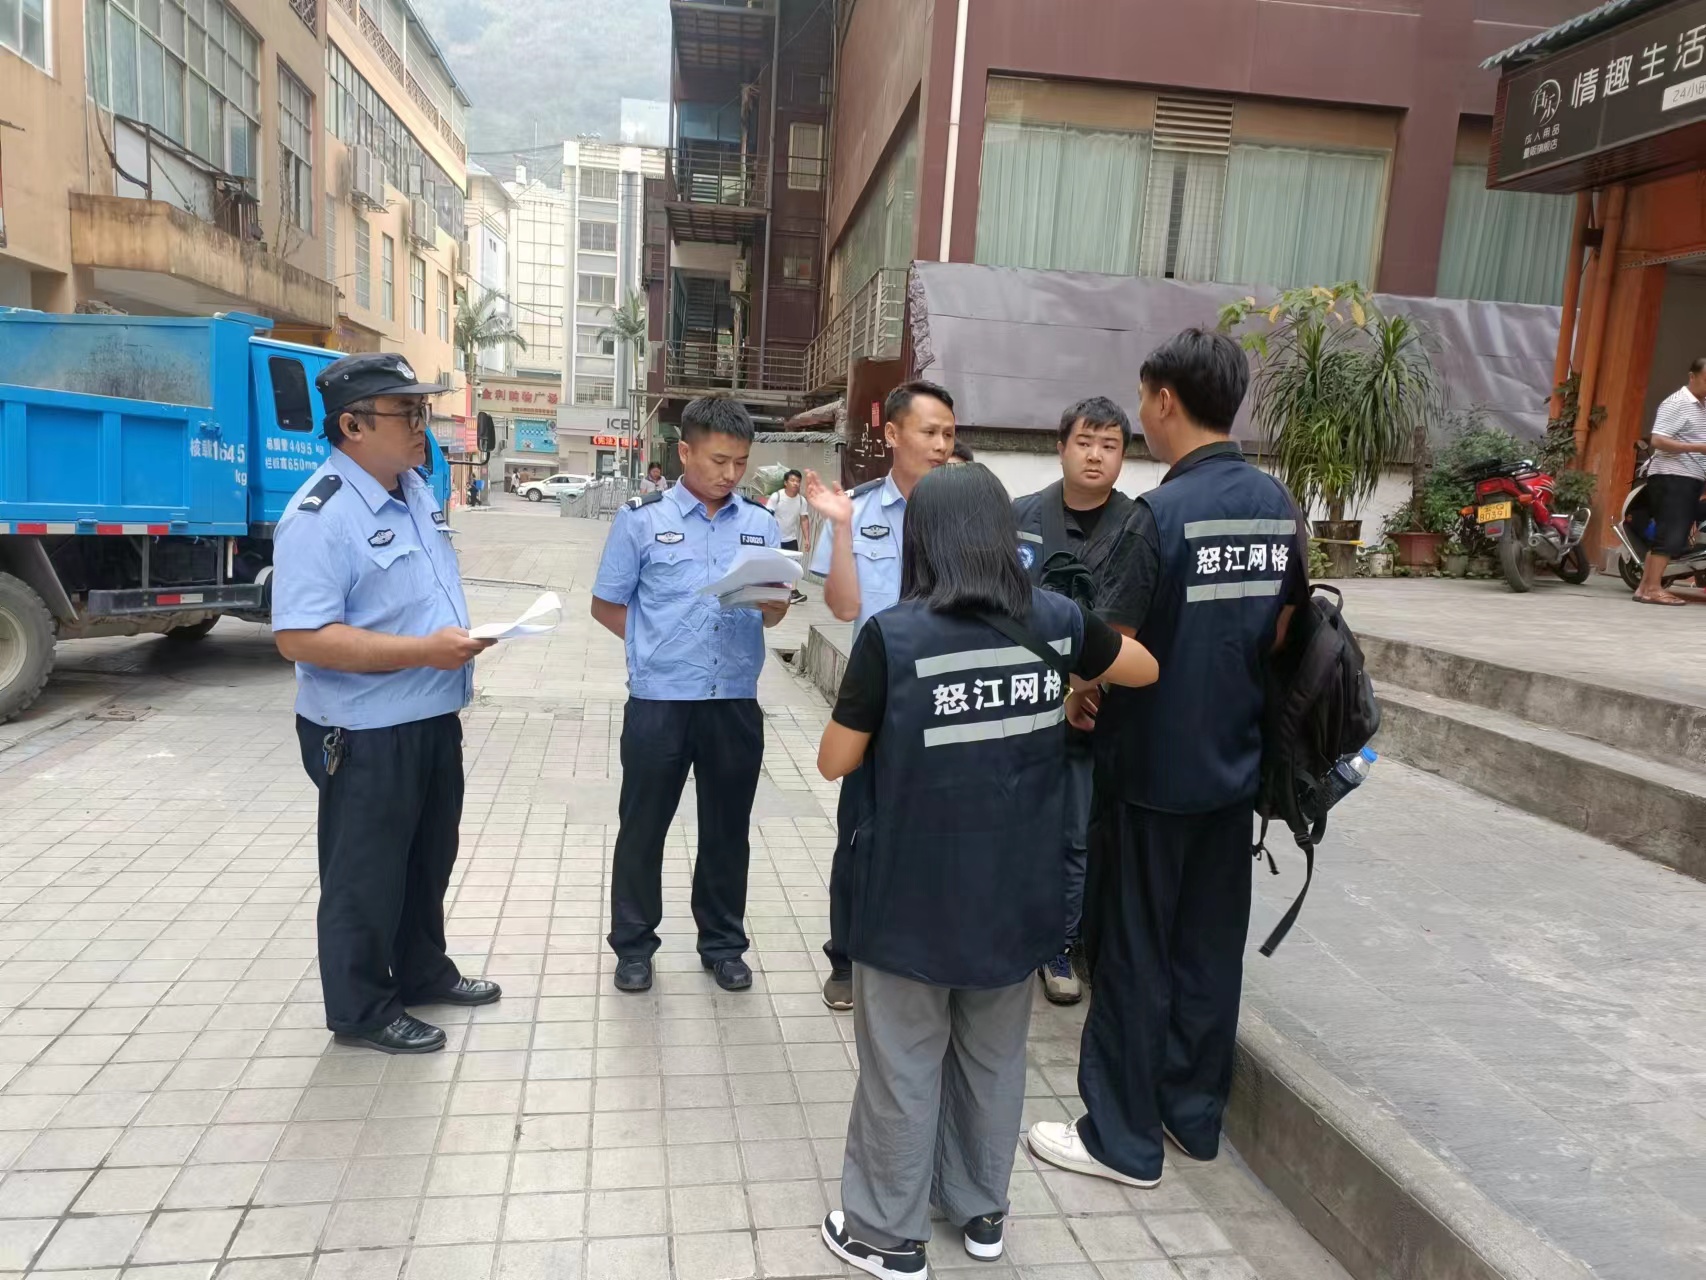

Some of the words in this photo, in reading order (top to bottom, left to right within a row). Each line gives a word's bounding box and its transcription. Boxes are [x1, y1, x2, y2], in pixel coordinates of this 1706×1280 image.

[1570, 23, 1706, 109] 情趣生活
[1524, 123, 1560, 146] 成人用品
[235, 469, 248, 486] kg
[1195, 543, 1290, 575] 怒江网格
[932, 668, 1062, 717] 怒江网格
